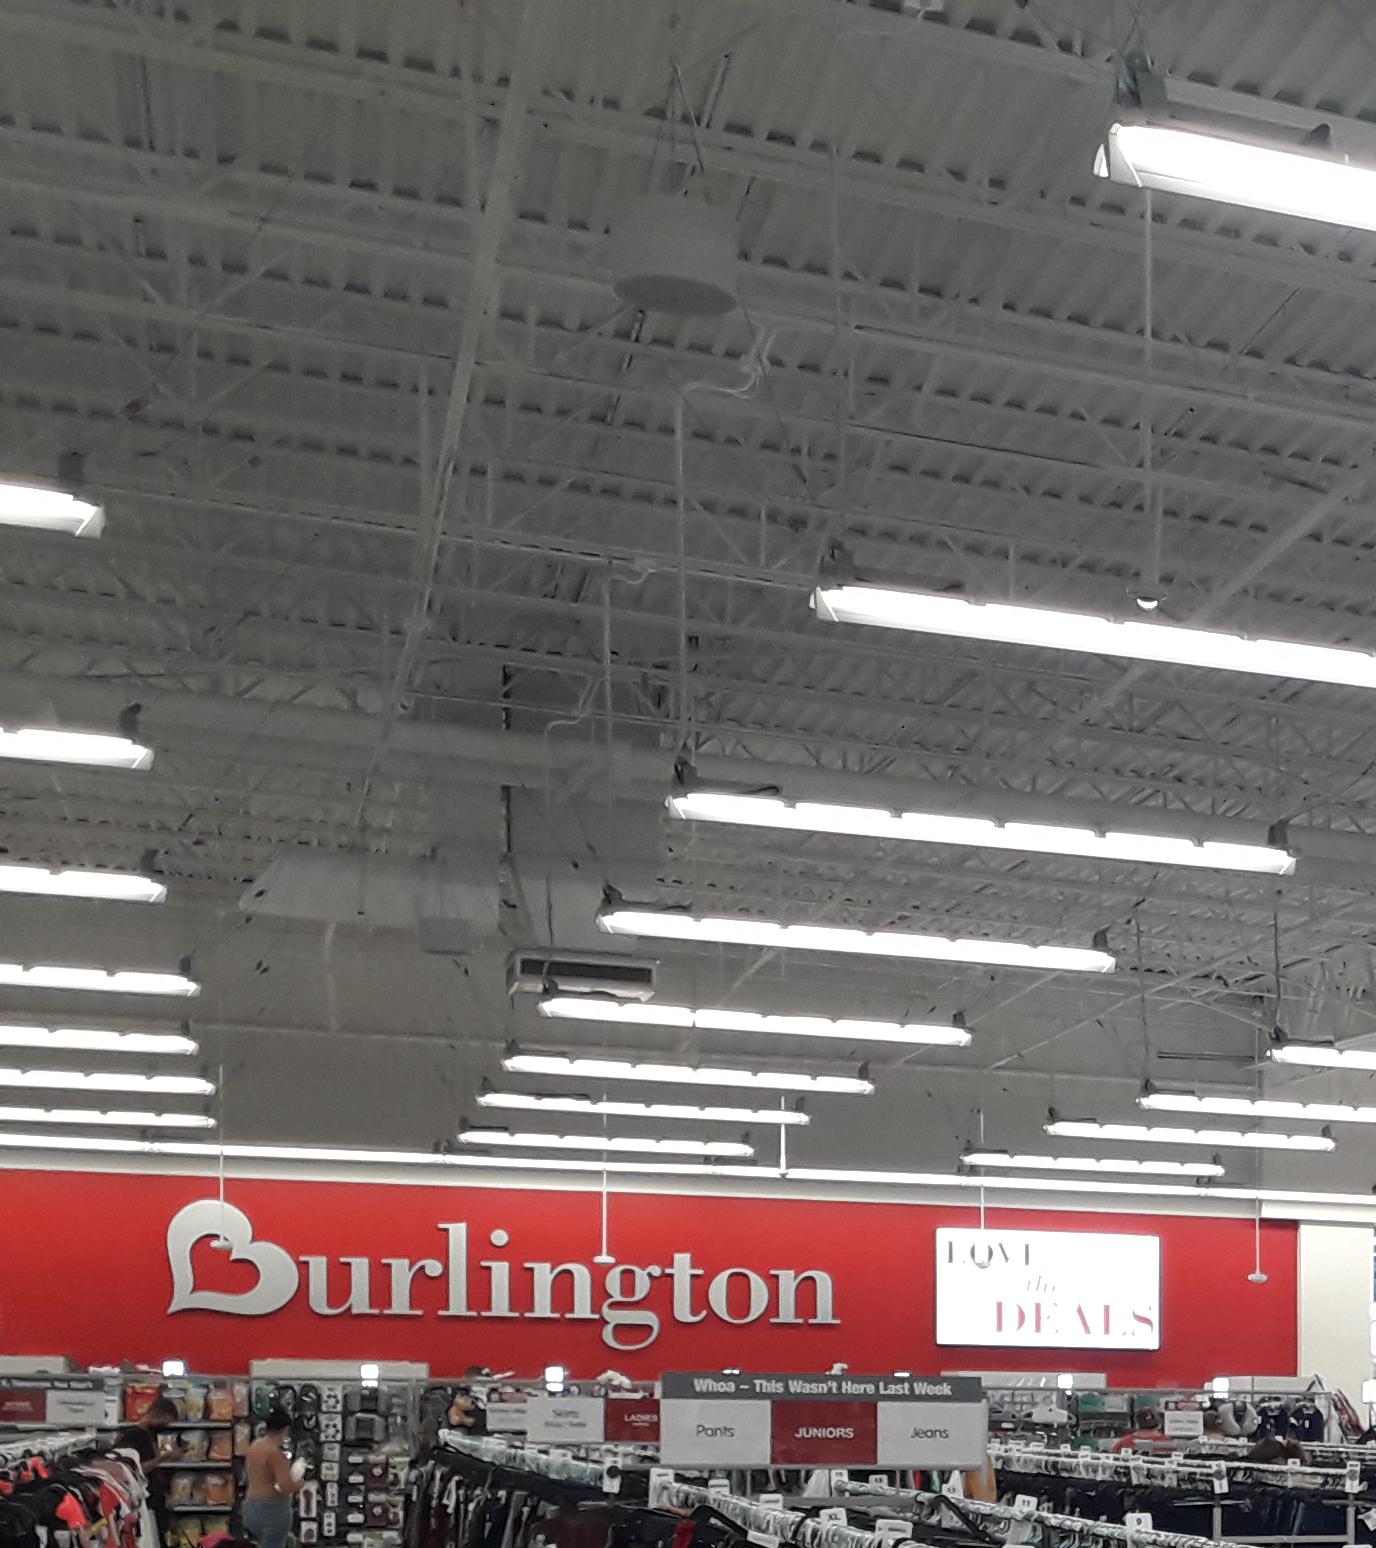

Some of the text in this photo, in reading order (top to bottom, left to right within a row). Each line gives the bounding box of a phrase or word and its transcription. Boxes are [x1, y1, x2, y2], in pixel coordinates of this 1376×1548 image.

[167, 1200, 841, 1351] Burlington
[693, 1379, 736, 1393] Whoa
[753, 1379, 784, 1394] This
[788, 1380, 838, 1395] Wasn't
[841, 1381, 875, 1396] Here
[878, 1382, 910, 1396] Last
[912, 1382, 953, 1397] Week
[696, 1424, 736, 1438] Pants
[794, 1427, 855, 1439] JUNIORS
[910, 1427, 949, 1440] Jeans
[1135, 1517, 1143, 1526] 9
